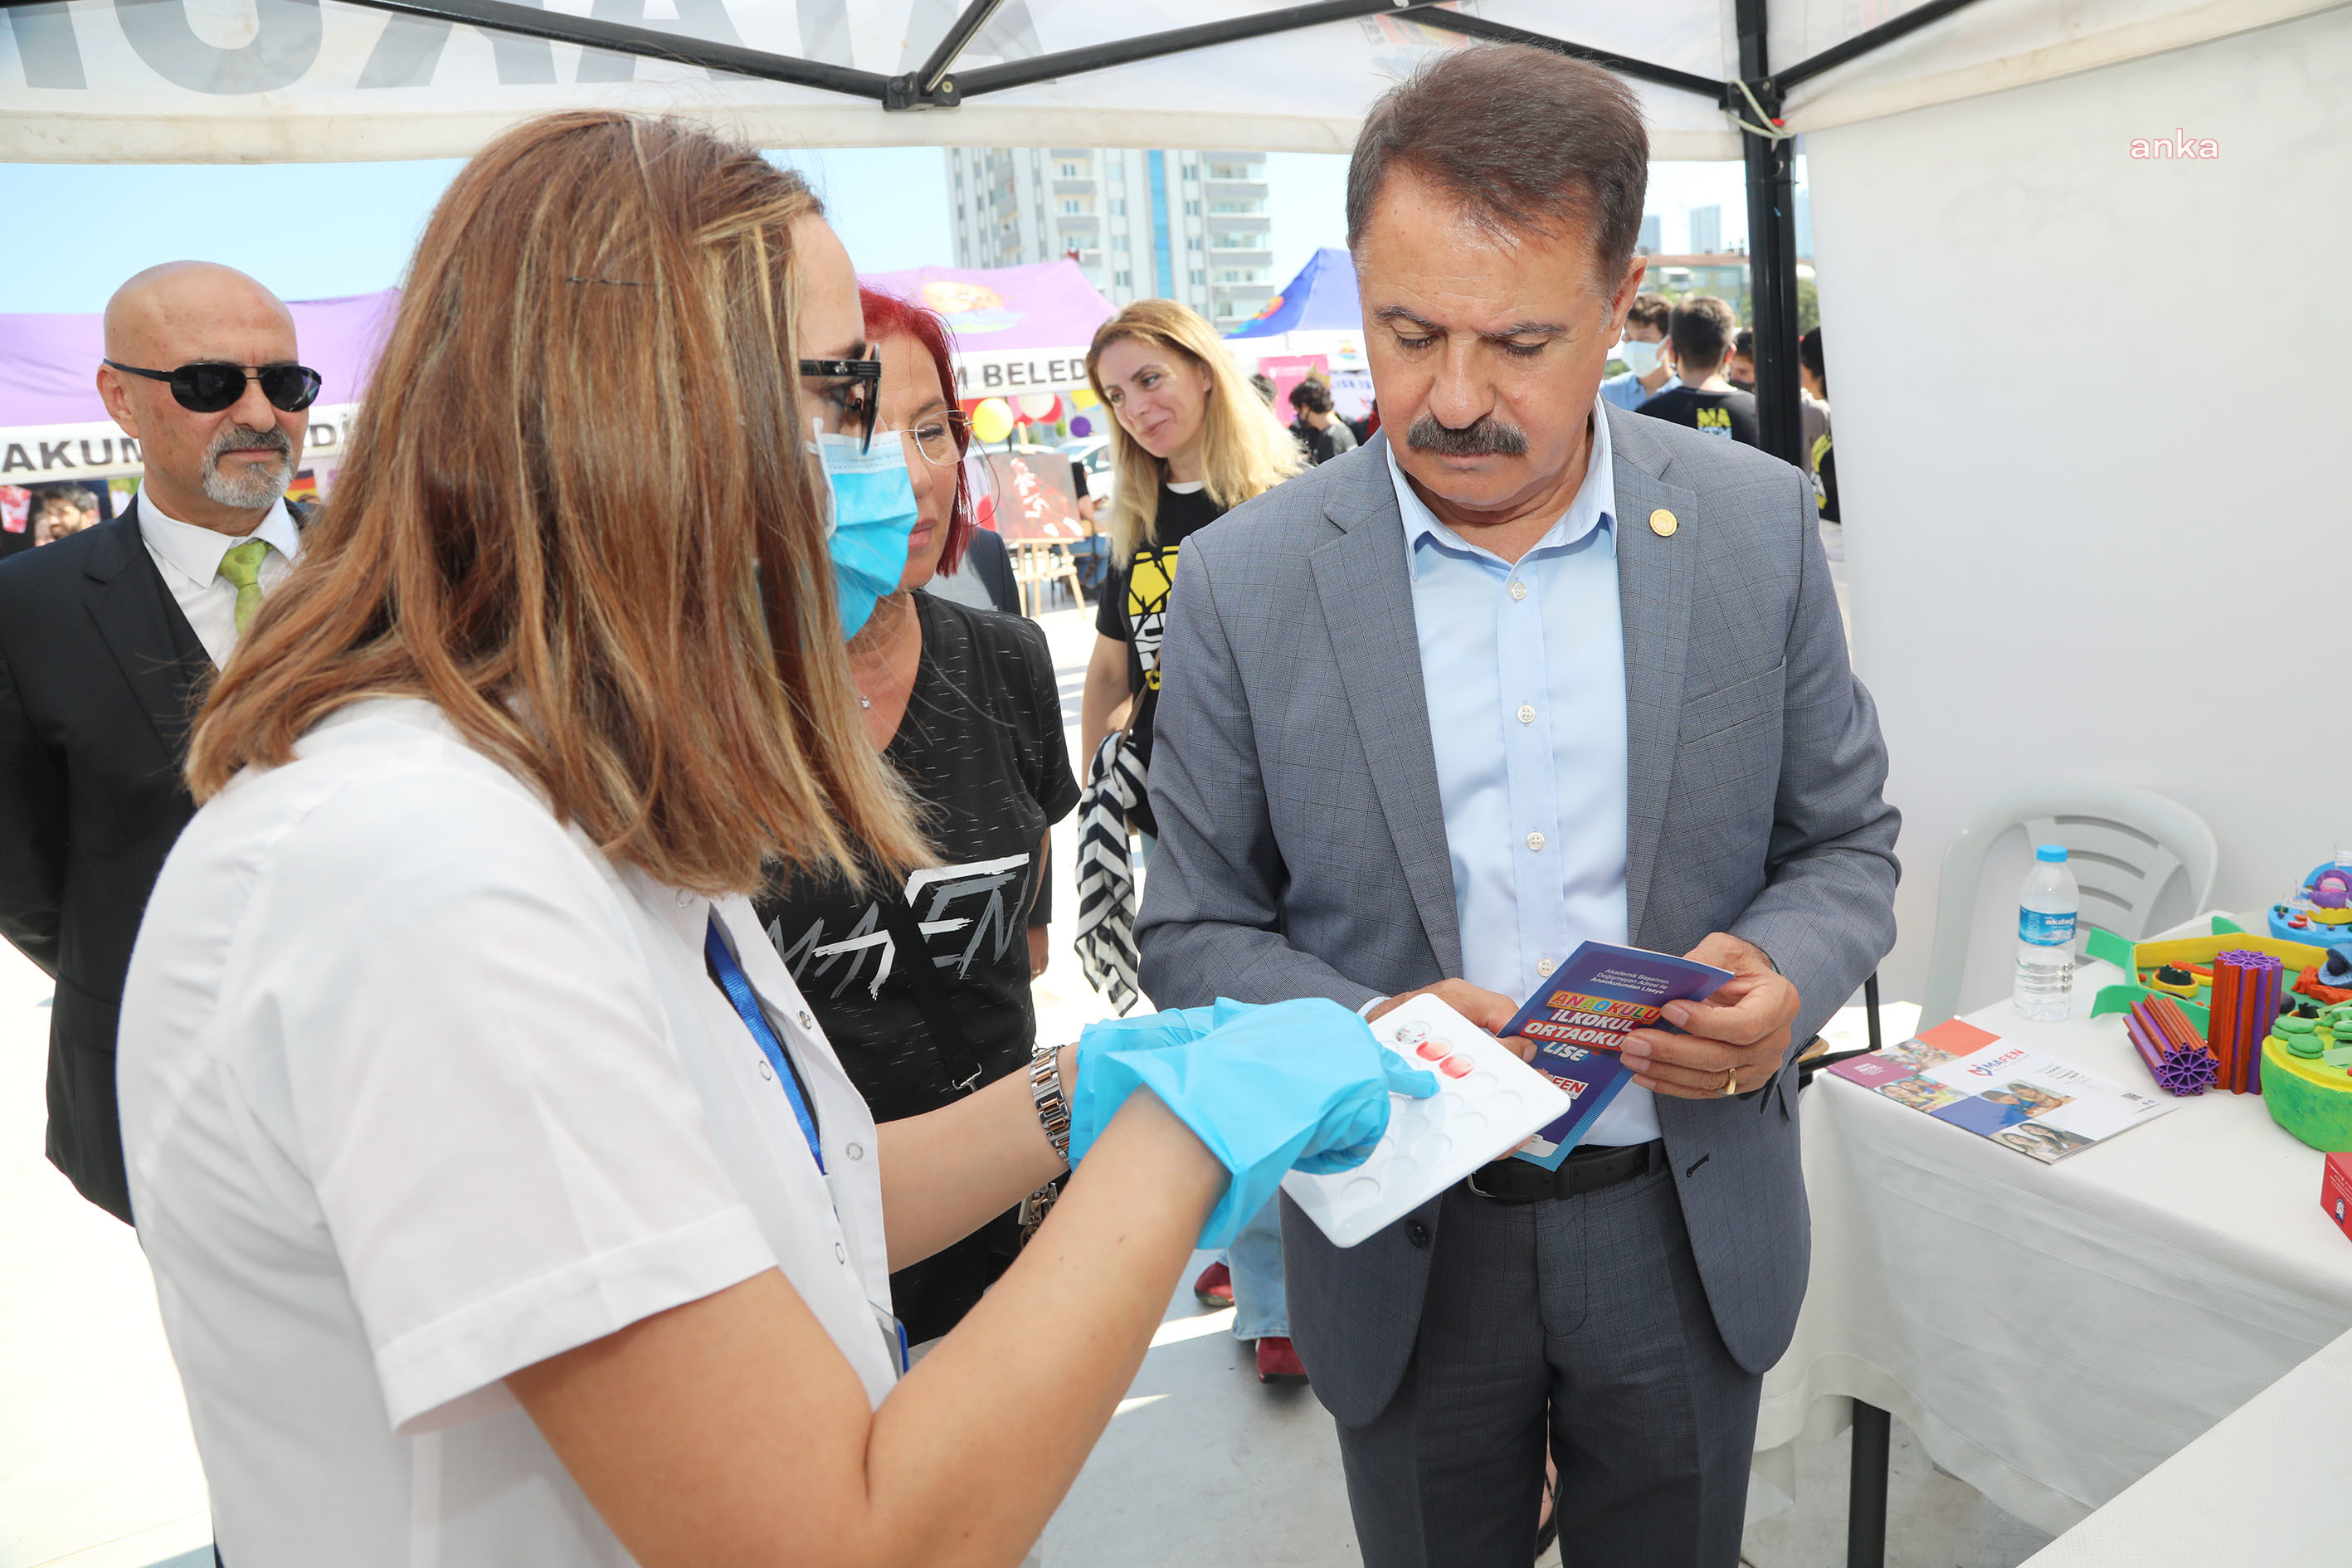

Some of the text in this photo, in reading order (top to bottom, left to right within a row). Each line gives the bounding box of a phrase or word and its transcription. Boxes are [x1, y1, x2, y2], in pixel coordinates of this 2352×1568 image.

[982, 358, 1088, 387] BELED
[1590, 977, 1665, 995] Anaokulundan Liseye
[1549, 993, 1660, 1021] ANAOKULU
[1524, 1022, 1625, 1047] ORTAOKU
[1981, 1048, 2025, 1069] MAFEN
[1552, 1077, 1586, 1093] FEN
